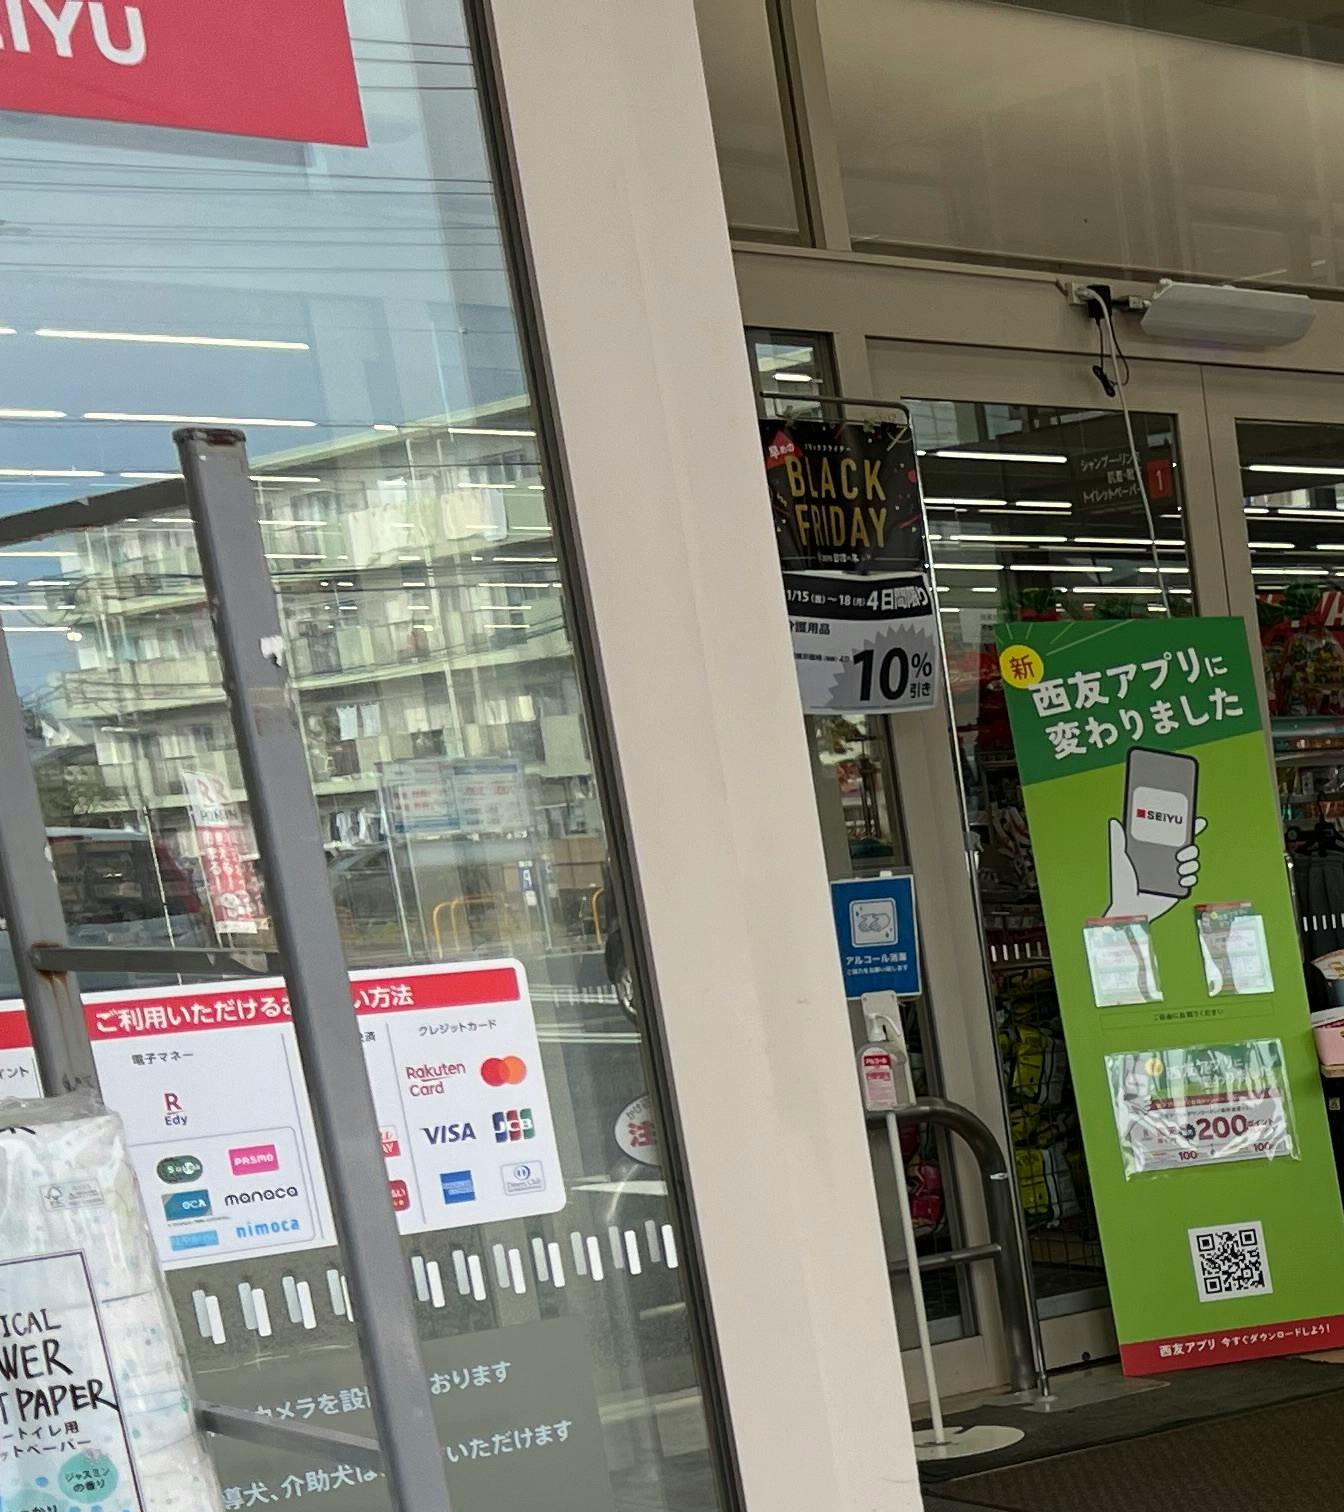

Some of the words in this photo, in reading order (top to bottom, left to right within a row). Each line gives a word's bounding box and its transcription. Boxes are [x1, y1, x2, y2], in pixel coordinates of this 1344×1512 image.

[0, 0, 147, 66] IYU
[785, 455, 887, 501] BLACK
[1156, 469, 1164, 492] 1
[795, 504, 888, 549] FRIDAY
[867, 585, 929, 611] 4日間限り
[853, 647, 933, 702] 10%
[1009, 652, 1036, 682] 新
[909, 682, 932, 699] 引き
[1027, 647, 1229, 718] 西友アプリに
[1045, 687, 1245, 760] 変わりました
[1146, 809, 1184, 826] SEIYU
[846, 951, 908, 965] アルコール消毒
[418, 1020, 498, 1038] クレジットカード
[131, 1051, 195, 1067] 電子マネー
[406, 1061, 467, 1082] Rakuten
[409, 1080, 447, 1098] Card
[164, 1092, 184, 1114] R
[164, 1115, 188, 1127] Edy
[1195, 1113, 1249, 1142] 200
[421, 1122, 478, 1145] VISA
[233, 1153, 275, 1166] PASMO
[224, 1186, 299, 1206] manaca
[235, 1218, 300, 1239] nimoca
[1159, 1338, 1217, 1358] 西友アプリ
[15, 1378, 120, 1423] PAPER
[73, 1478, 106, 1494] の香り
